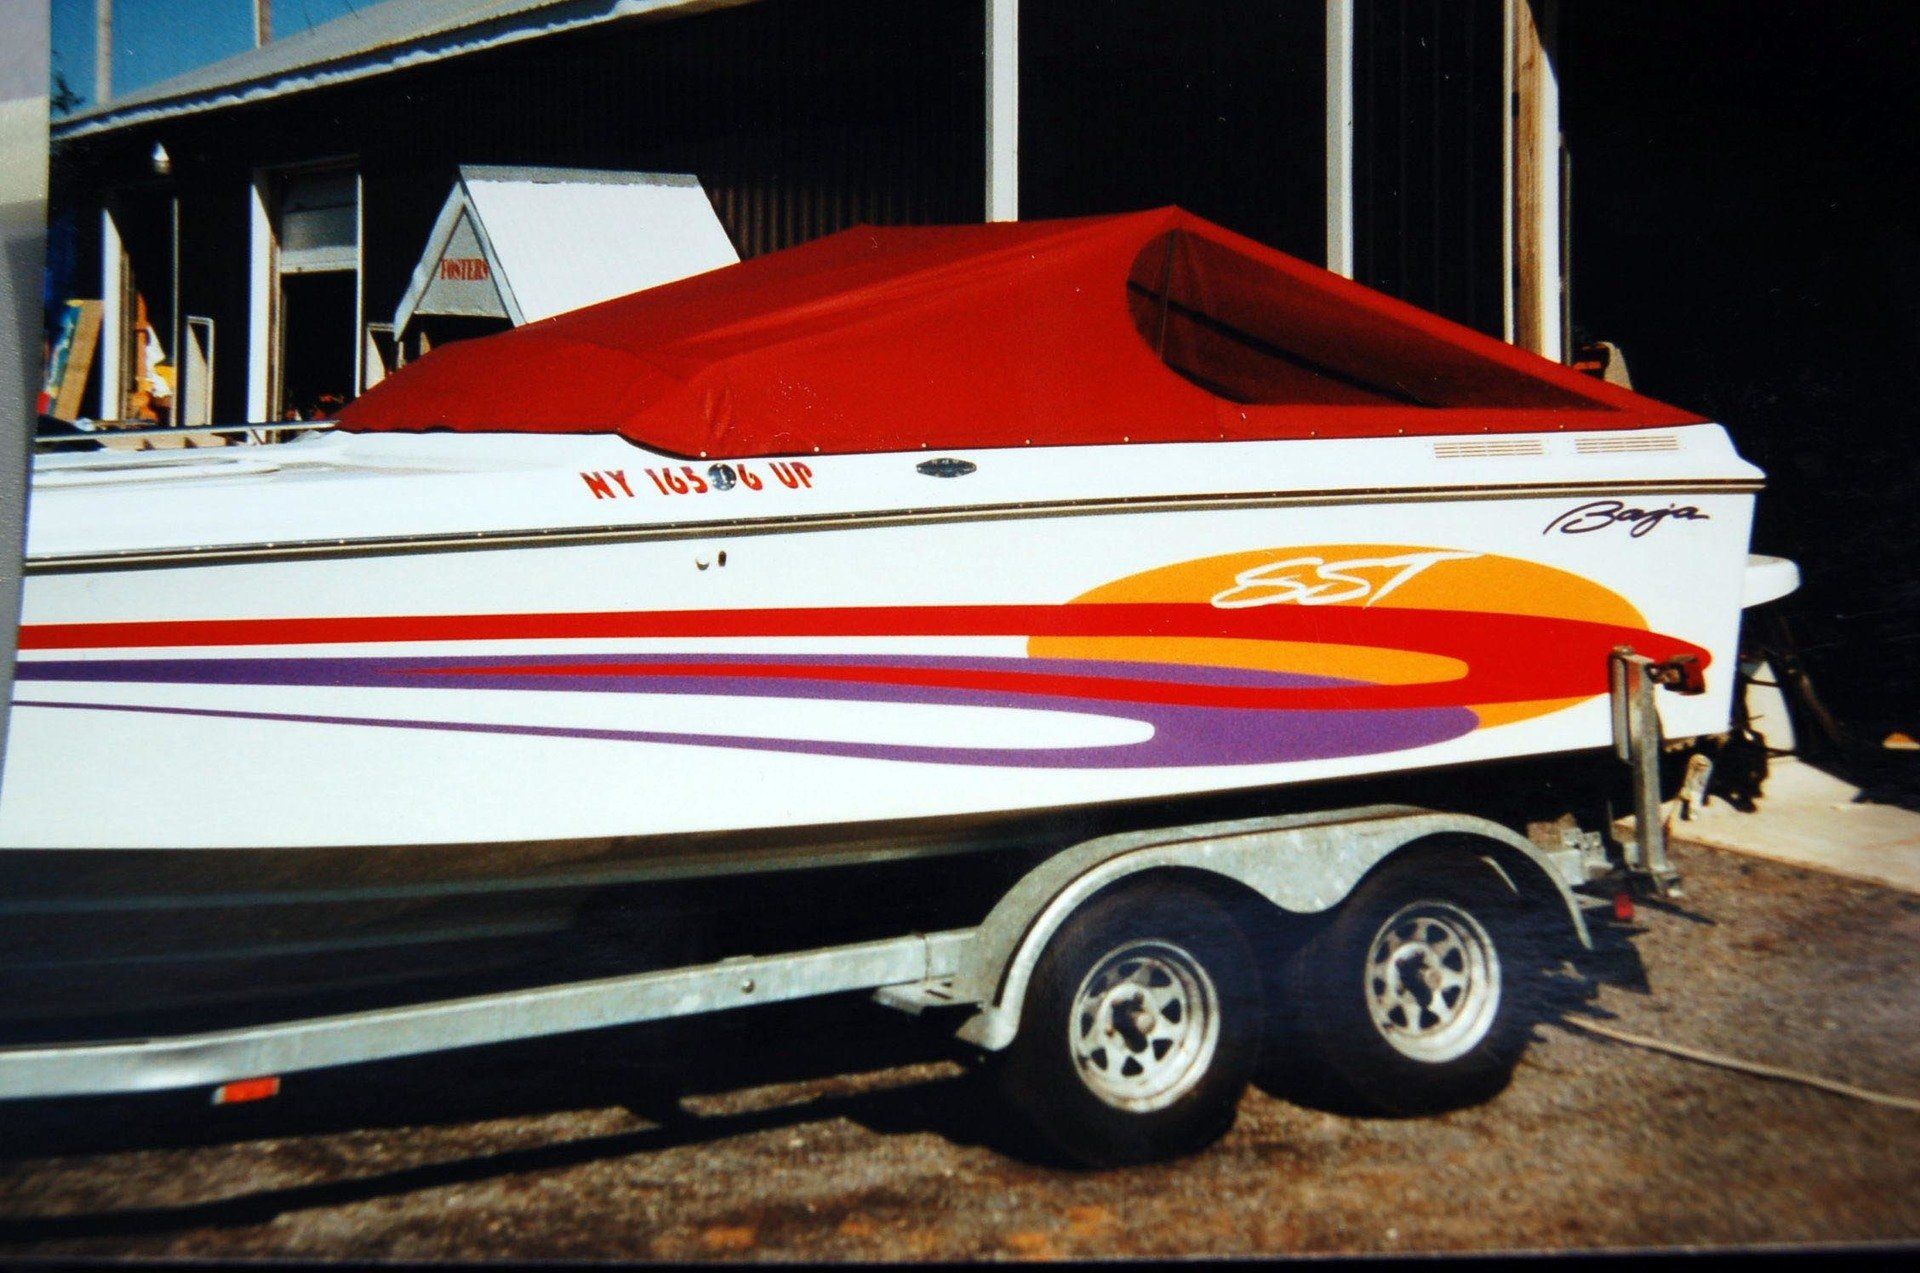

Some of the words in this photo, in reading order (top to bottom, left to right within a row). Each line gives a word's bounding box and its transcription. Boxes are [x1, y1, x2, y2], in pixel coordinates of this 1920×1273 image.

[580, 470, 635, 500] NY
[768, 461, 813, 489] UP
[1542, 500, 1710, 538] Baja
[1211, 550, 1486, 608] SST
